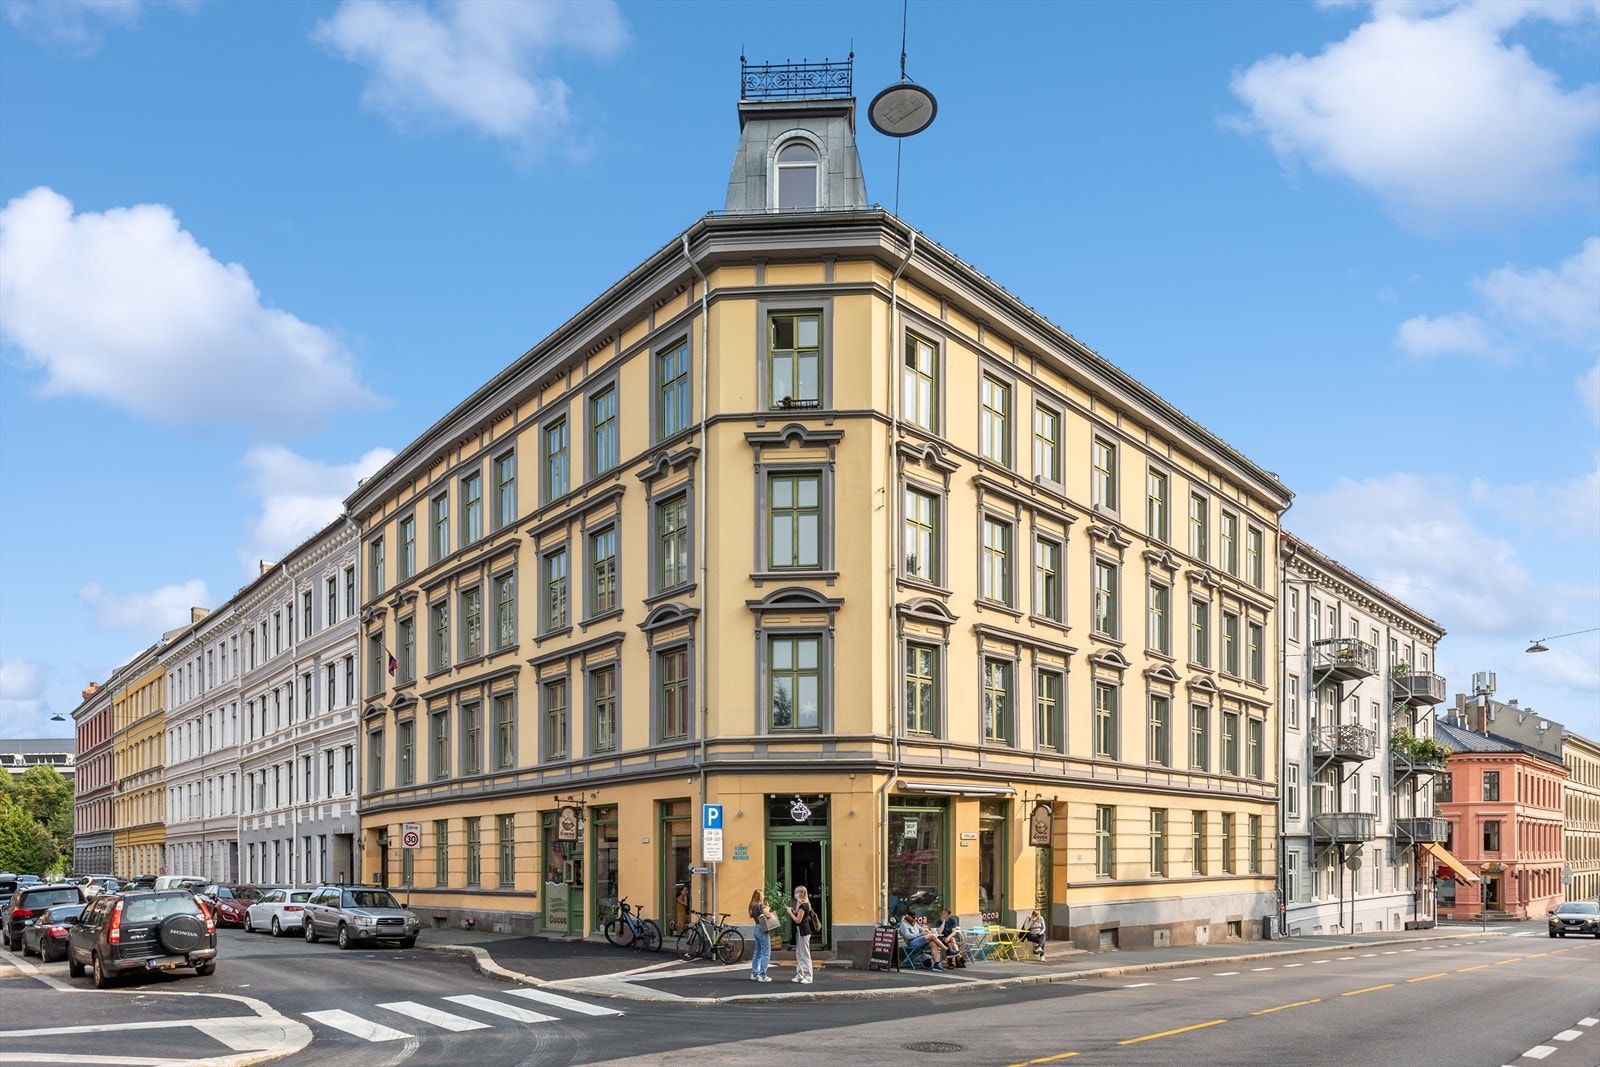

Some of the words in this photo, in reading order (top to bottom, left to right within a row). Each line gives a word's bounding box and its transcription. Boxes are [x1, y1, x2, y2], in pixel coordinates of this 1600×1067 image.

[708, 808, 718, 826] P
[406, 835, 416, 844] 30
[549, 915, 566, 924] Cocoa
